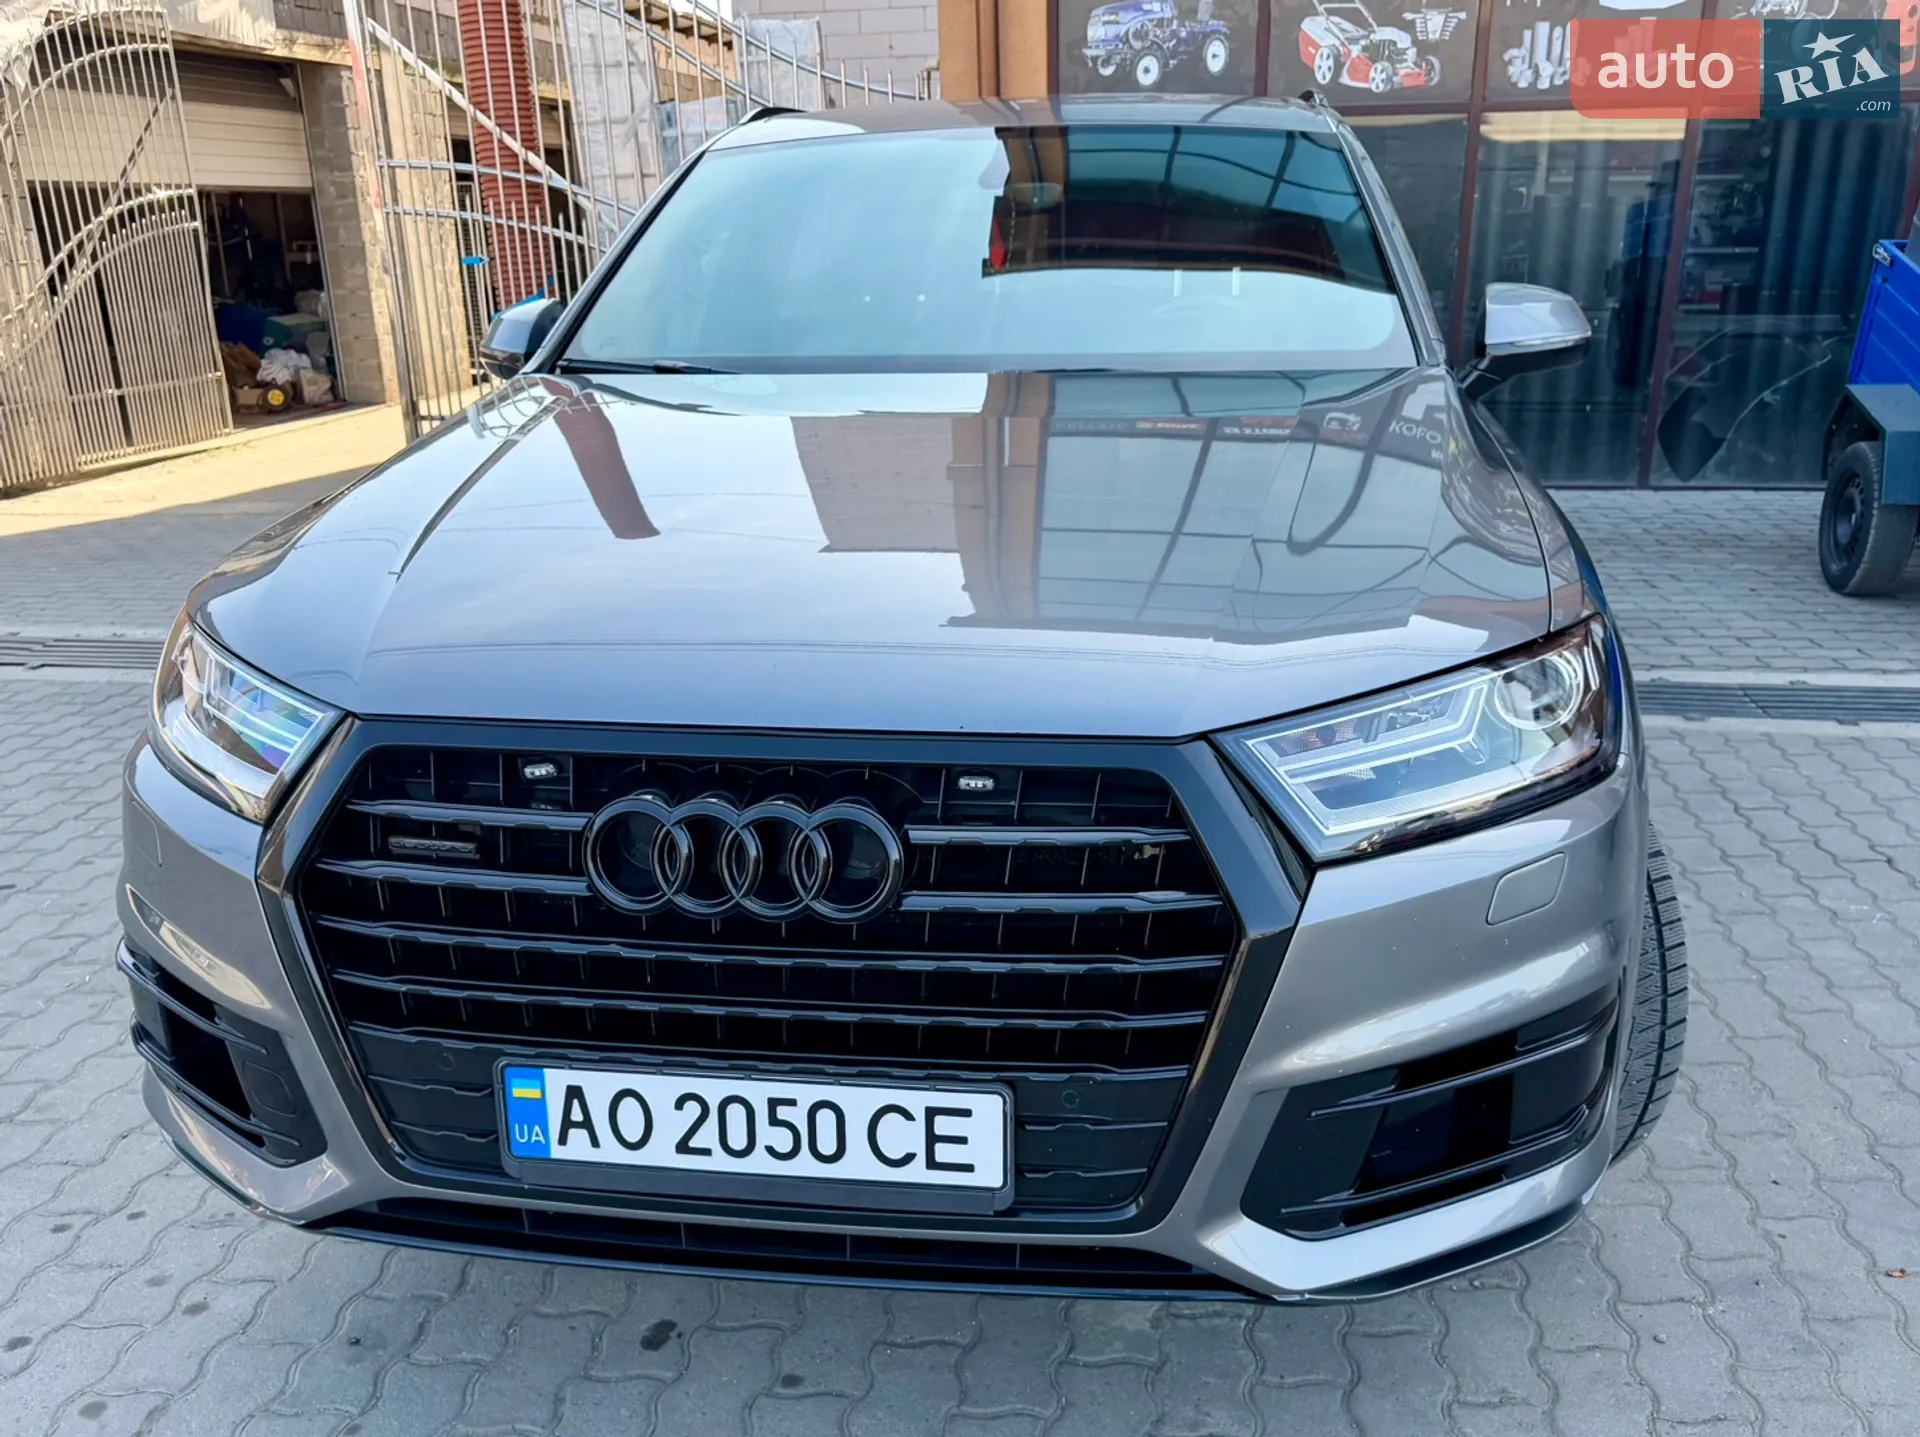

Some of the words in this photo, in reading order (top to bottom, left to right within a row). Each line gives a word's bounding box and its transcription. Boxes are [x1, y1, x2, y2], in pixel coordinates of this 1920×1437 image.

[515, 1123, 546, 1145] UA
[556, 1084, 654, 1151] AO
[673, 1092, 847, 1165] 2050
[867, 1103, 976, 1174] CE
